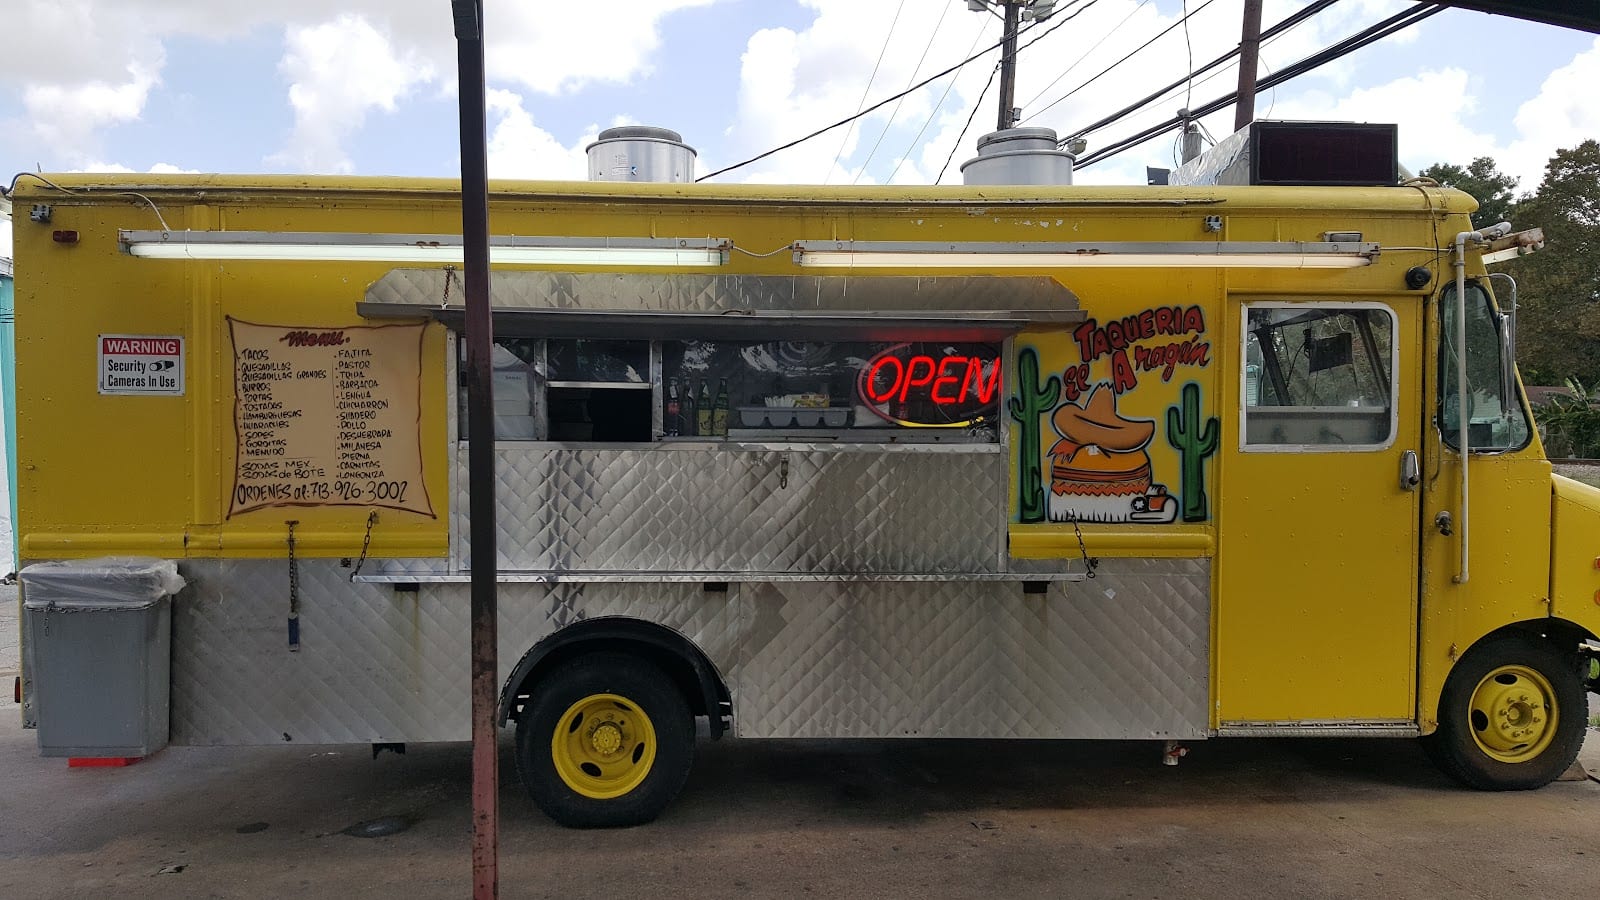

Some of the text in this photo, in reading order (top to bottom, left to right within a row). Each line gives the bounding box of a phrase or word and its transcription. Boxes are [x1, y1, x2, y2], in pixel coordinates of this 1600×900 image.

[1073, 305, 1204, 362] TAQUERIA
[107, 340, 176, 353] WARNING
[241, 350, 269, 361] TACOS
[338, 350, 372, 358] FAJITA
[108, 360, 146, 374] Security
[241, 362, 291, 373] QUESADILLAS
[338, 361, 370, 369] PASTOR
[241, 370, 327, 382] QUESADILLAS GRANDES
[340, 371, 366, 379] TRIPA
[866, 356, 1001, 404] OPEN
[108, 375, 175, 387] Cameras In Use
[339, 380, 380, 389] BARBACOA
[1064, 363, 1091, 400] El
[242, 383, 271, 393] BURROS
[244, 393, 273, 402] TORTAS
[340, 391, 372, 400] LENGUA
[243, 402, 283, 411] TOSTADAS
[338, 399, 389, 410] CHICHARRON
[243, 410, 302, 420] HAMBURGUESAS
[339, 410, 376, 420] SUADERO
[243, 420, 290, 430] HUARACHES
[340, 421, 367, 430] POLLO
[245, 430, 274, 439] SOPES
[245, 439, 287, 448] GORDITAS
[340, 441, 382, 451] MILANESA
[246, 447, 285, 456] MENUDO
[341, 452, 370, 460] PIERNA
[242, 461, 279, 472] SODAS
[340, 461, 381, 469] CARNITAS
[242, 468, 325, 479] SODAS de BOTE
[237, 483, 292, 505] ORDENES
